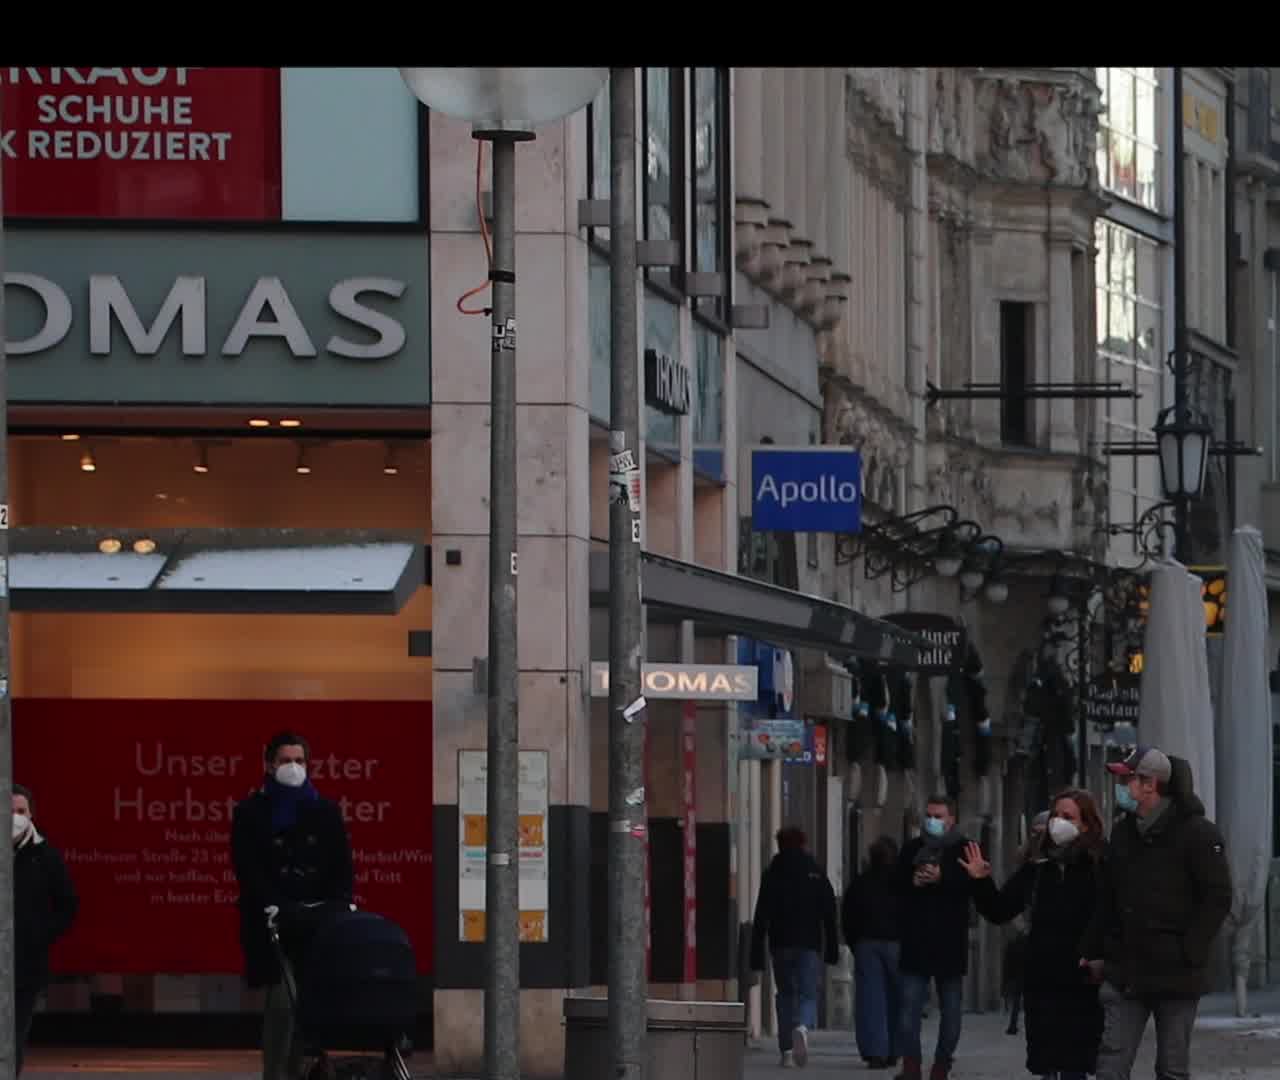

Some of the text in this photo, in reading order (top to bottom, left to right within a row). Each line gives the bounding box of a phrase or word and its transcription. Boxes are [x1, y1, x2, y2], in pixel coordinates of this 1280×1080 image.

[37, 95, 193, 125] SCHUHE
[27, 130, 232, 162] REDUZIERT
[757, 473, 857, 509] Apollo
[598, 669, 751, 694] TOMAS
[135, 740, 243, 777] Unser
